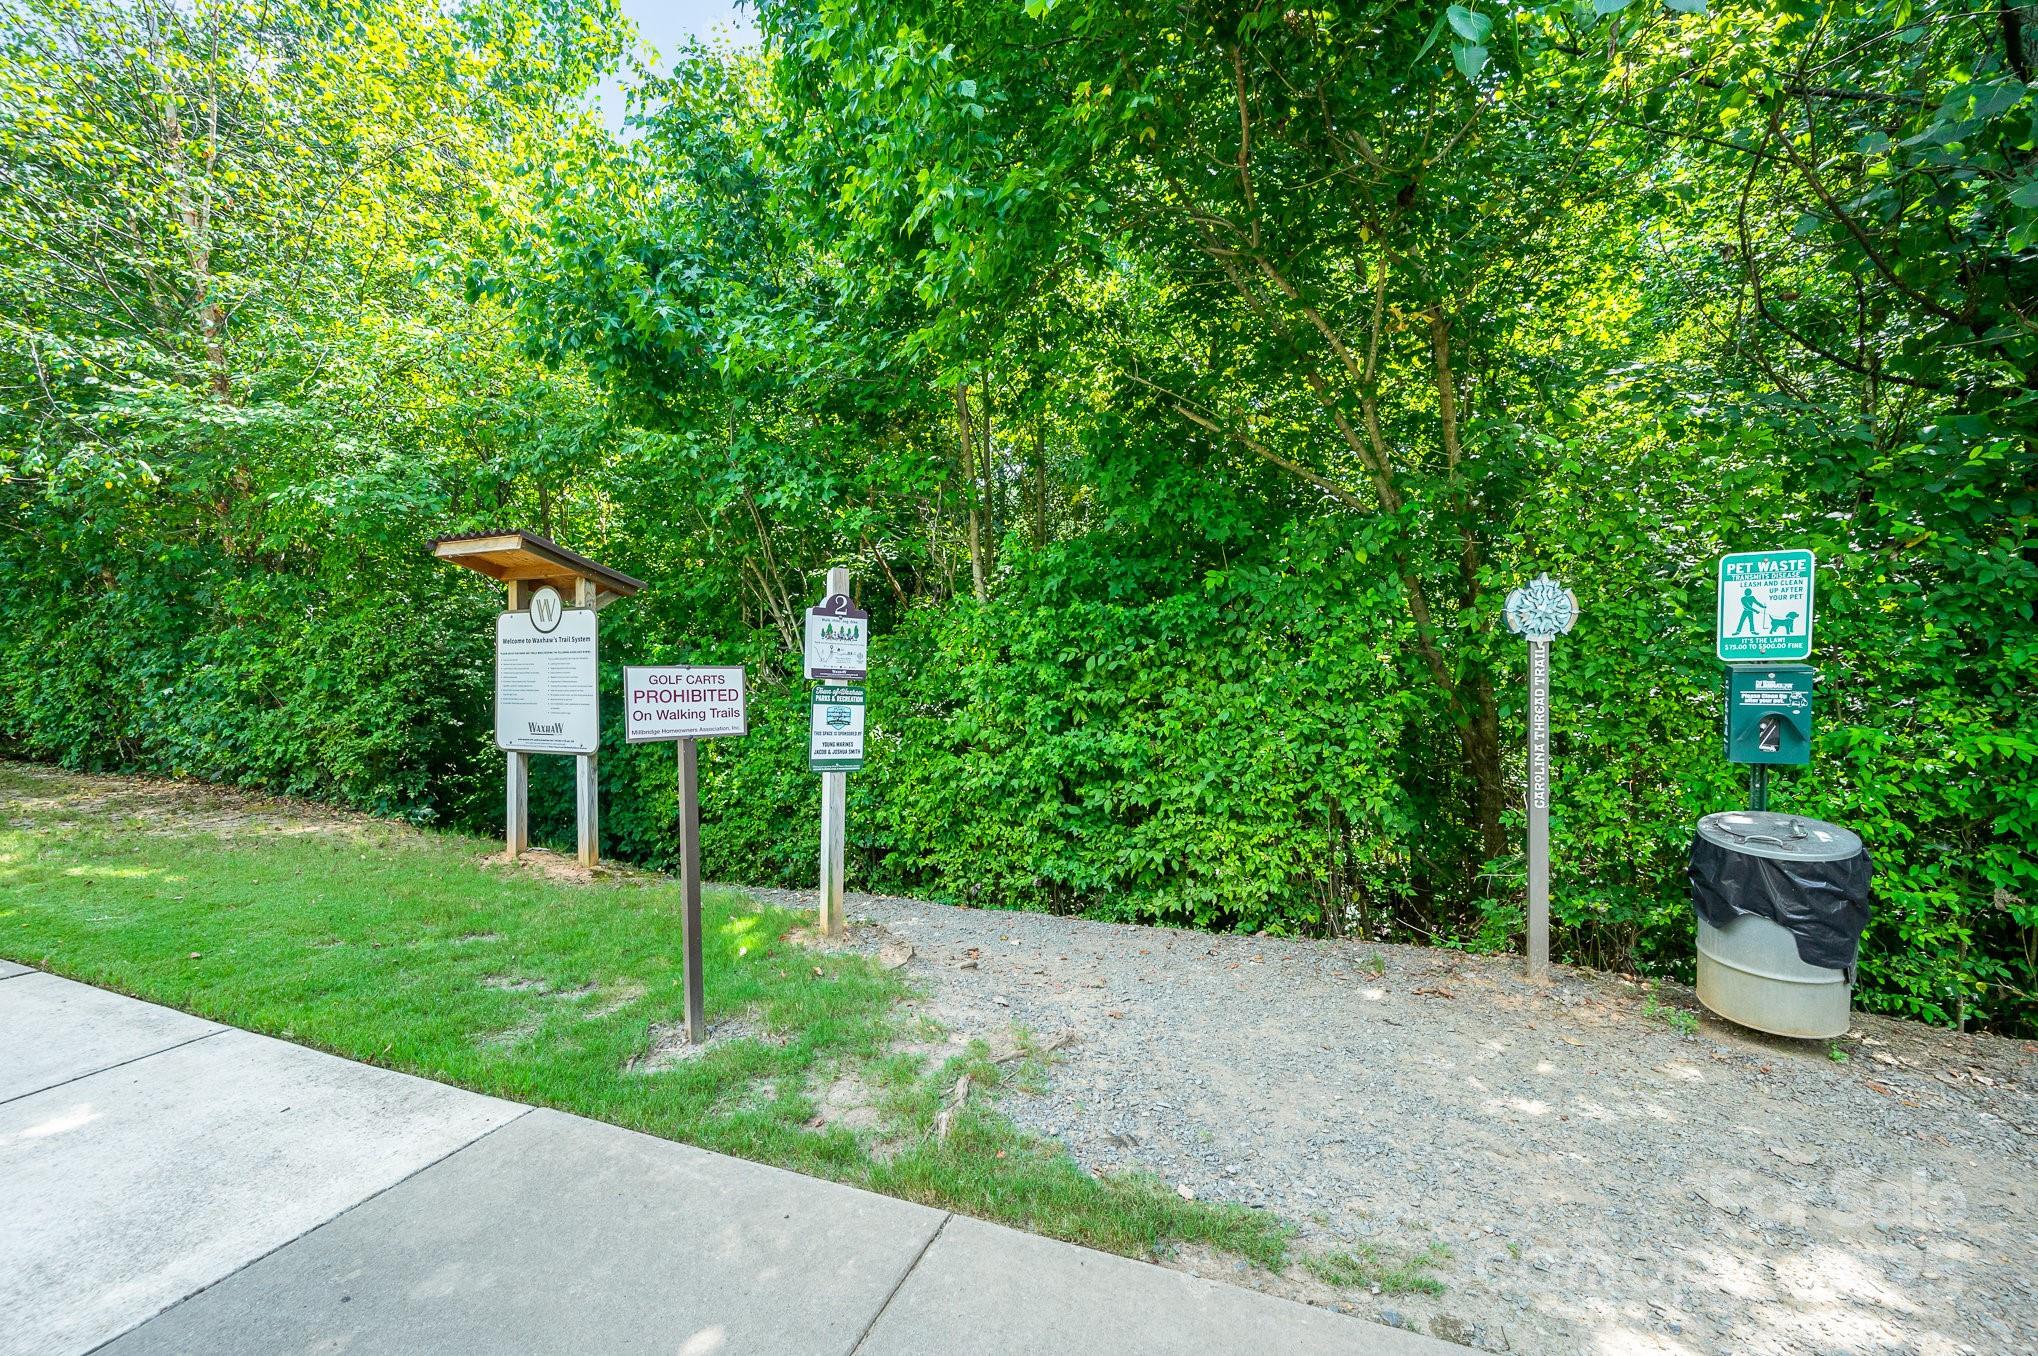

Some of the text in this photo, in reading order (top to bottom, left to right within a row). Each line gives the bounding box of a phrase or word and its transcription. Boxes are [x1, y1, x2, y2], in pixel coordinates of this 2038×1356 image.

[1727, 559, 1806, 574] PET WASTE
[1732, 571, 1800, 581] TRANSMITS DISEASE
[835, 596, 847, 615] 2
[649, 675, 725, 684] GOLF CARTS
[634, 689, 739, 703] PROHIBITED
[633, 708, 740, 721] On Walking Trails
[1534, 645, 1545, 809] CAROLINA THREAD TRAIL
